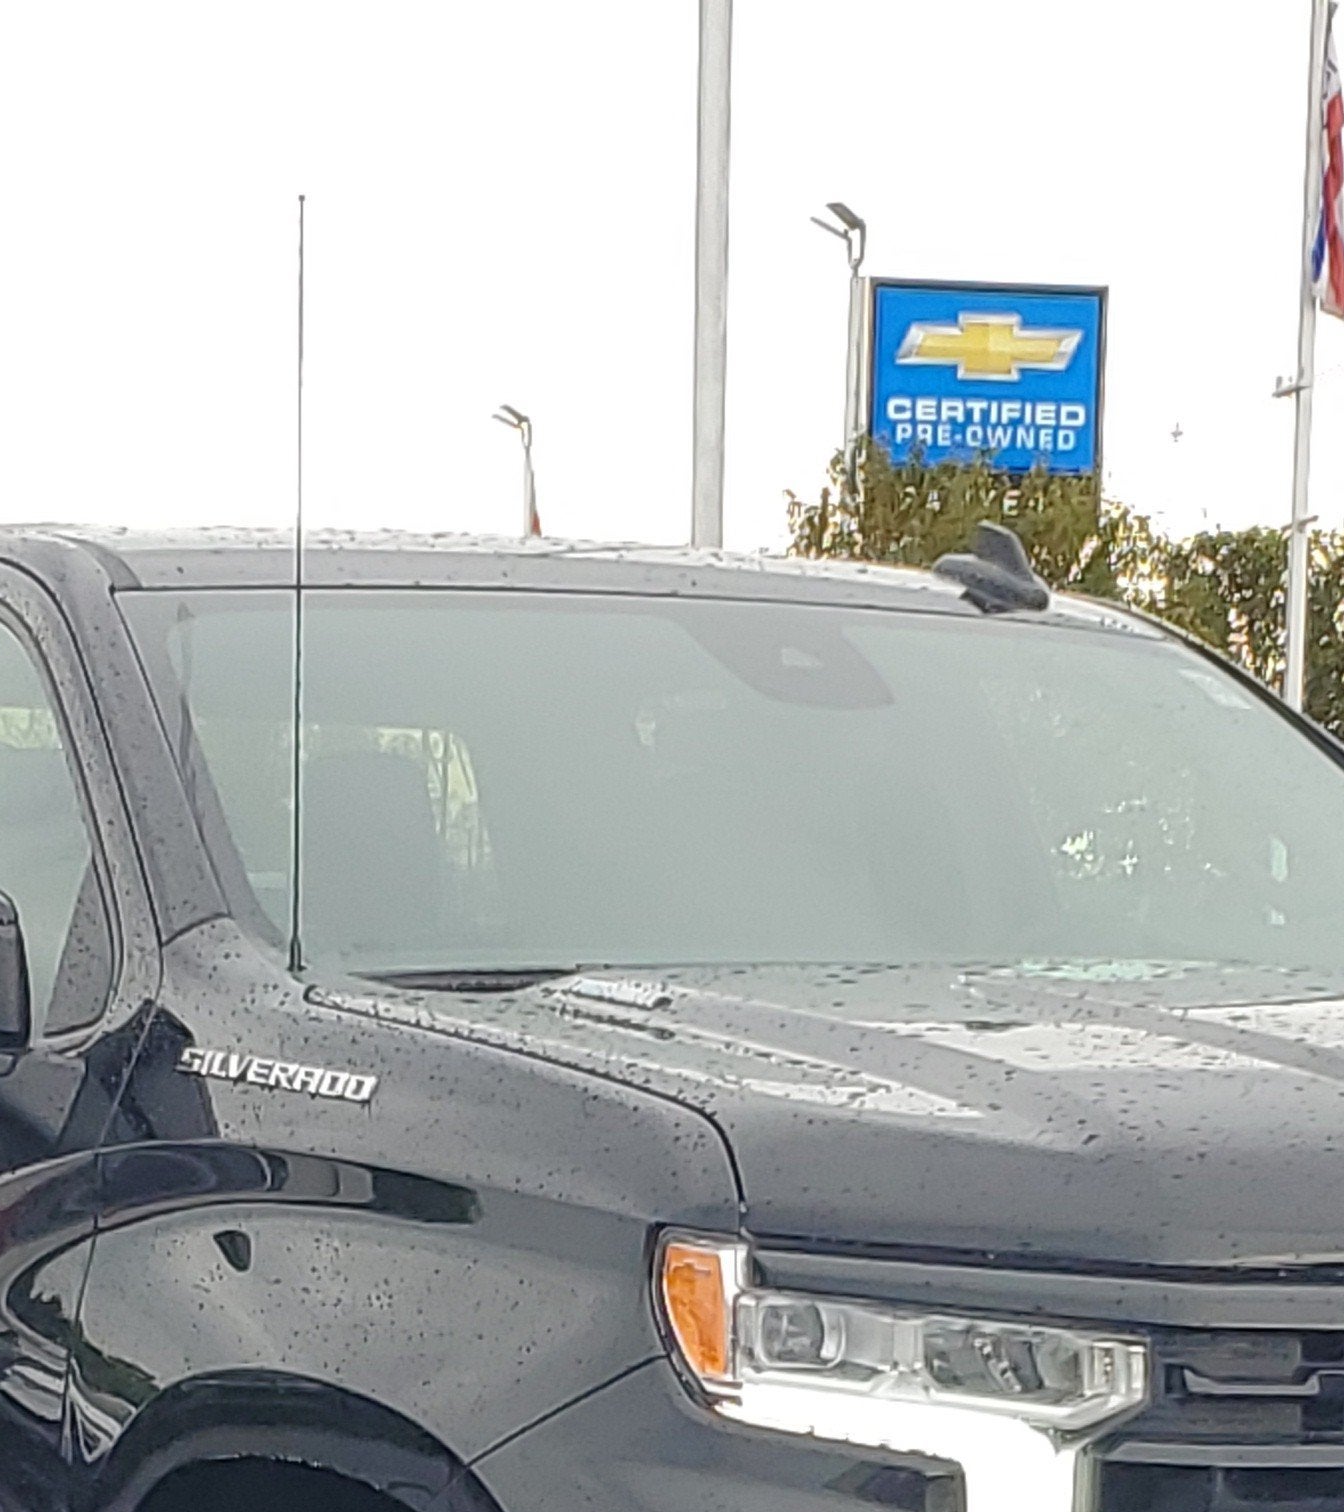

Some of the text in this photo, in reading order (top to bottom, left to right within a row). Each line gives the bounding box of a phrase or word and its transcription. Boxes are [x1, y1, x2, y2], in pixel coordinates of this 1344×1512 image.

[886, 397, 1086, 427] CERTIFIED
[895, 422, 1076, 451] PRE-OWNED
[175, 1047, 378, 1102] SILVERADO
